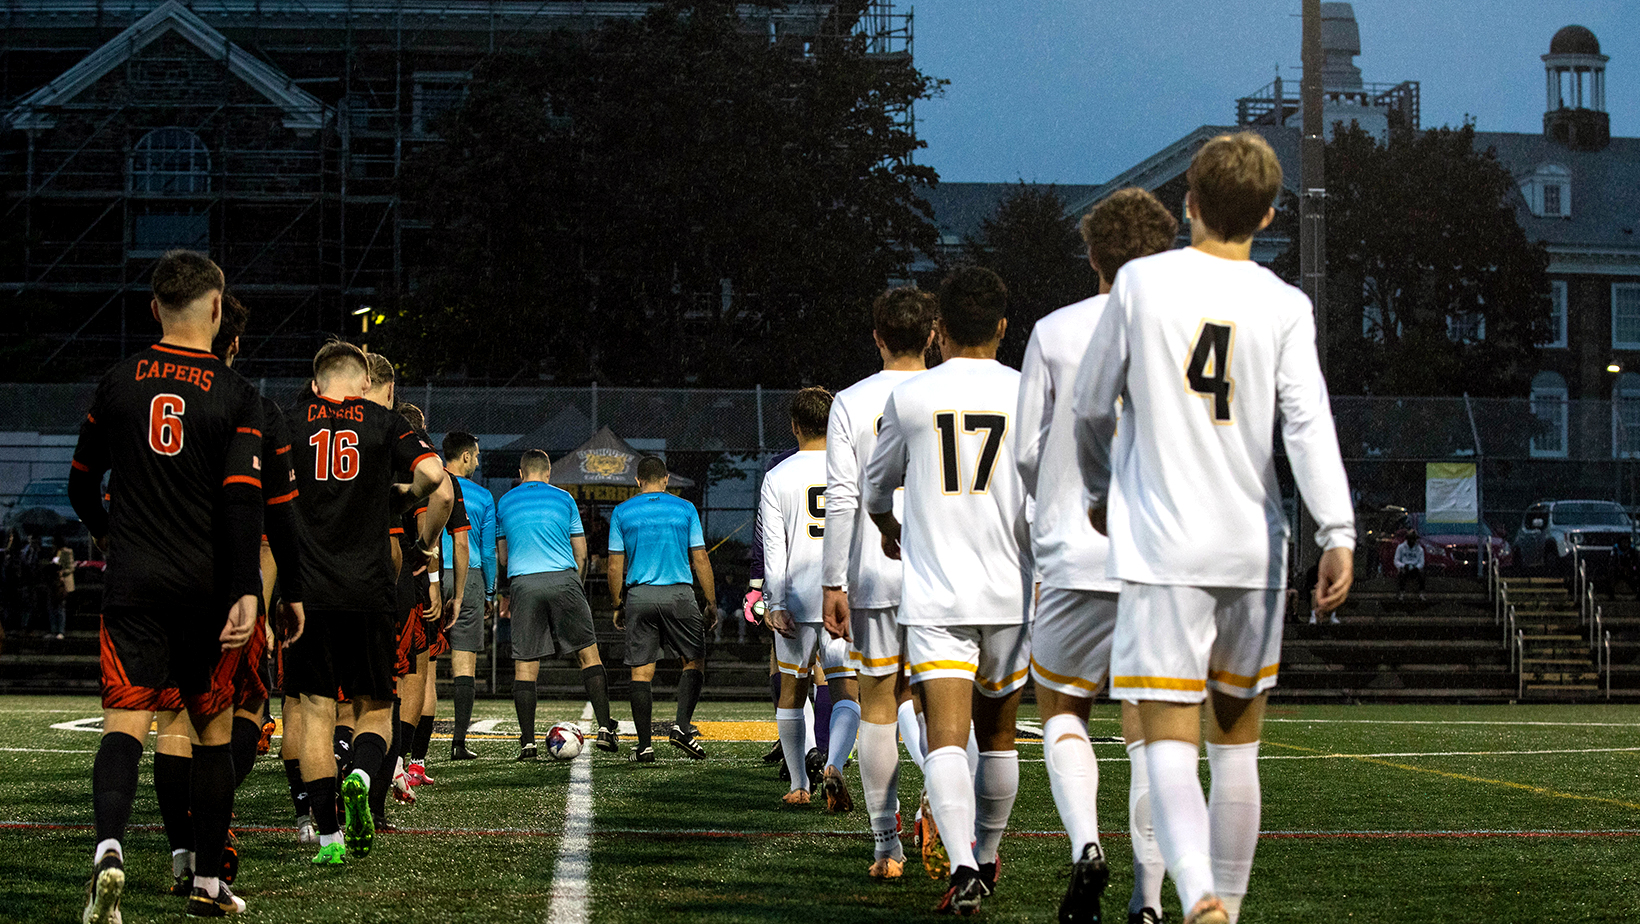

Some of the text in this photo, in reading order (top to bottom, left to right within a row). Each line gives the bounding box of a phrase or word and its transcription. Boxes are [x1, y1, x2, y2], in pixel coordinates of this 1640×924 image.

[135, 359, 214, 392] CAPERS
[1184, 317, 1236, 425] 4
[149, 393, 185, 456] 6
[307, 404, 364, 422] CARS
[309, 428, 360, 481] 16
[933, 409, 1009, 496] 17
[581, 485, 682, 501] TERRIY
